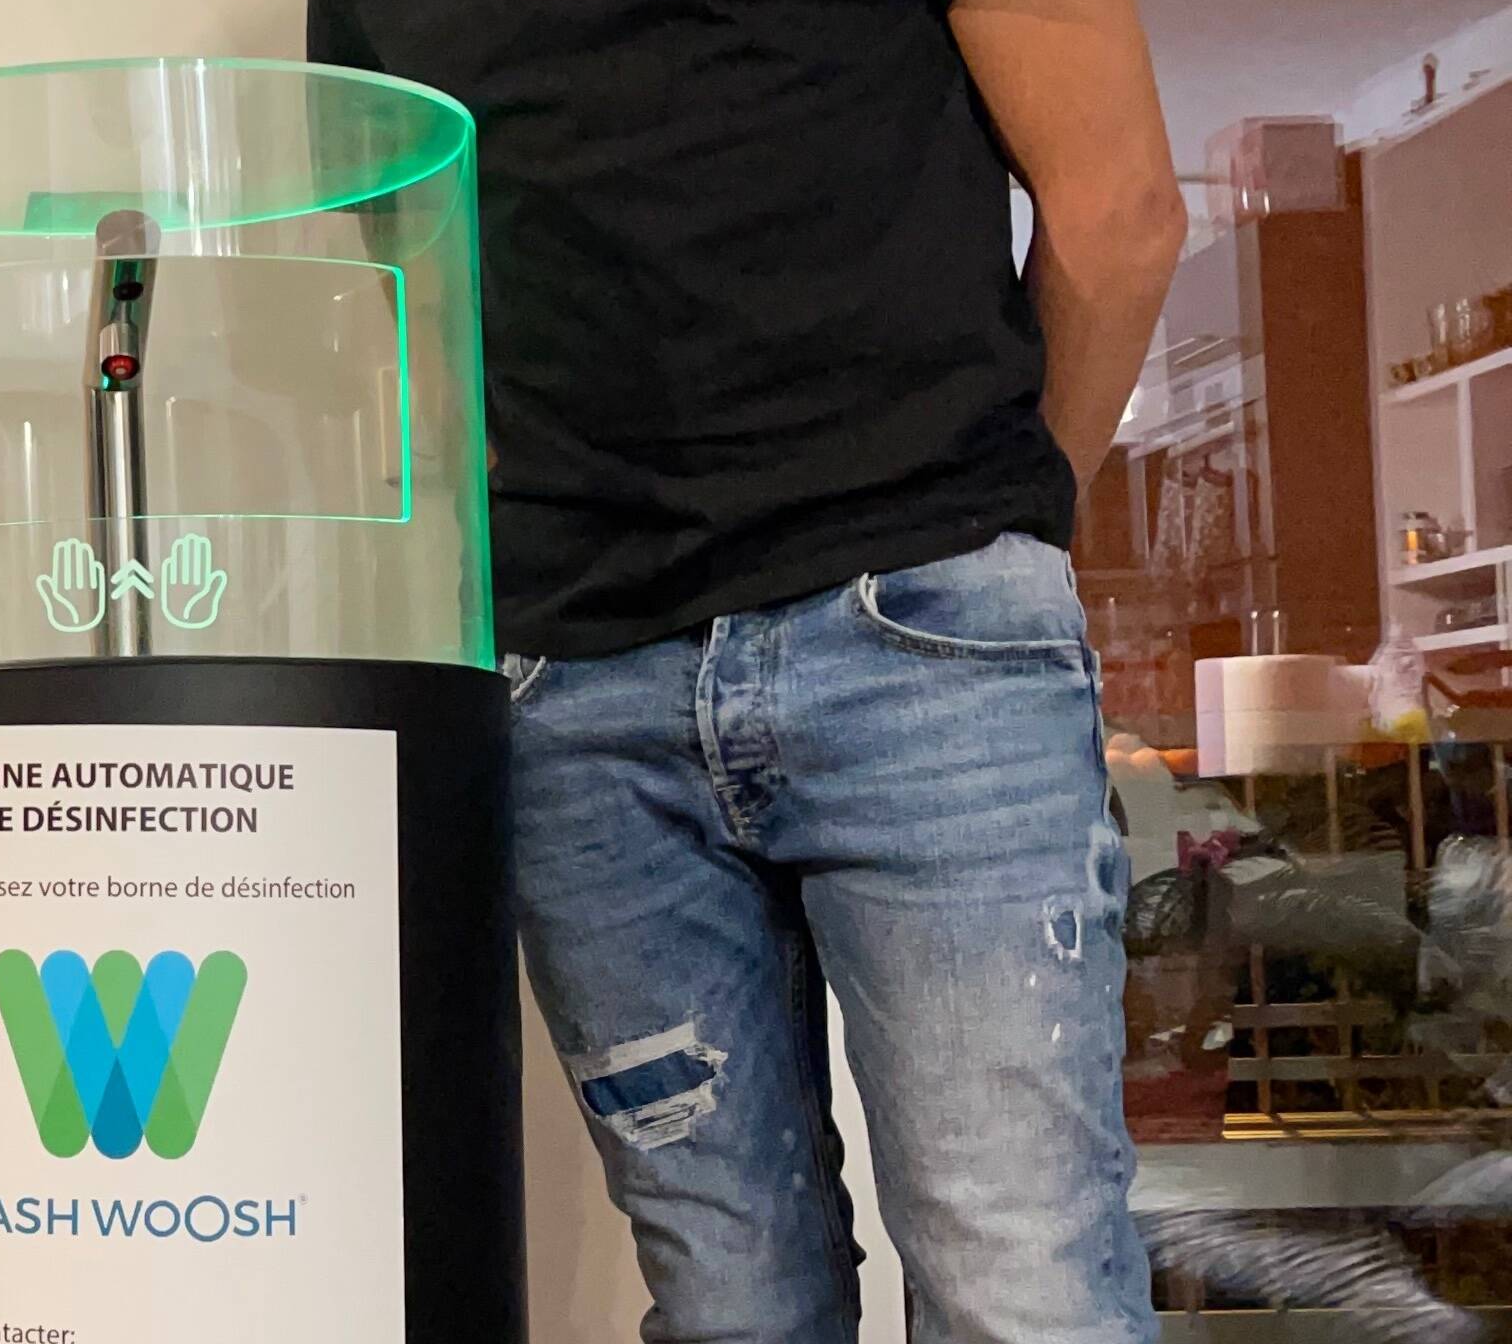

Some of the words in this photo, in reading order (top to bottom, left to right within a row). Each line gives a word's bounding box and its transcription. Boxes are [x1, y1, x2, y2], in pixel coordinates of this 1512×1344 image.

[51, 762, 295, 794] AUTOMATIQUE
[22, 799, 258, 833] DÉSINFECTION
[38, 878, 100, 898] votre
[107, 875, 178, 898] borne
[184, 875, 215, 898] de
[221, 875, 356, 899] désinfection
